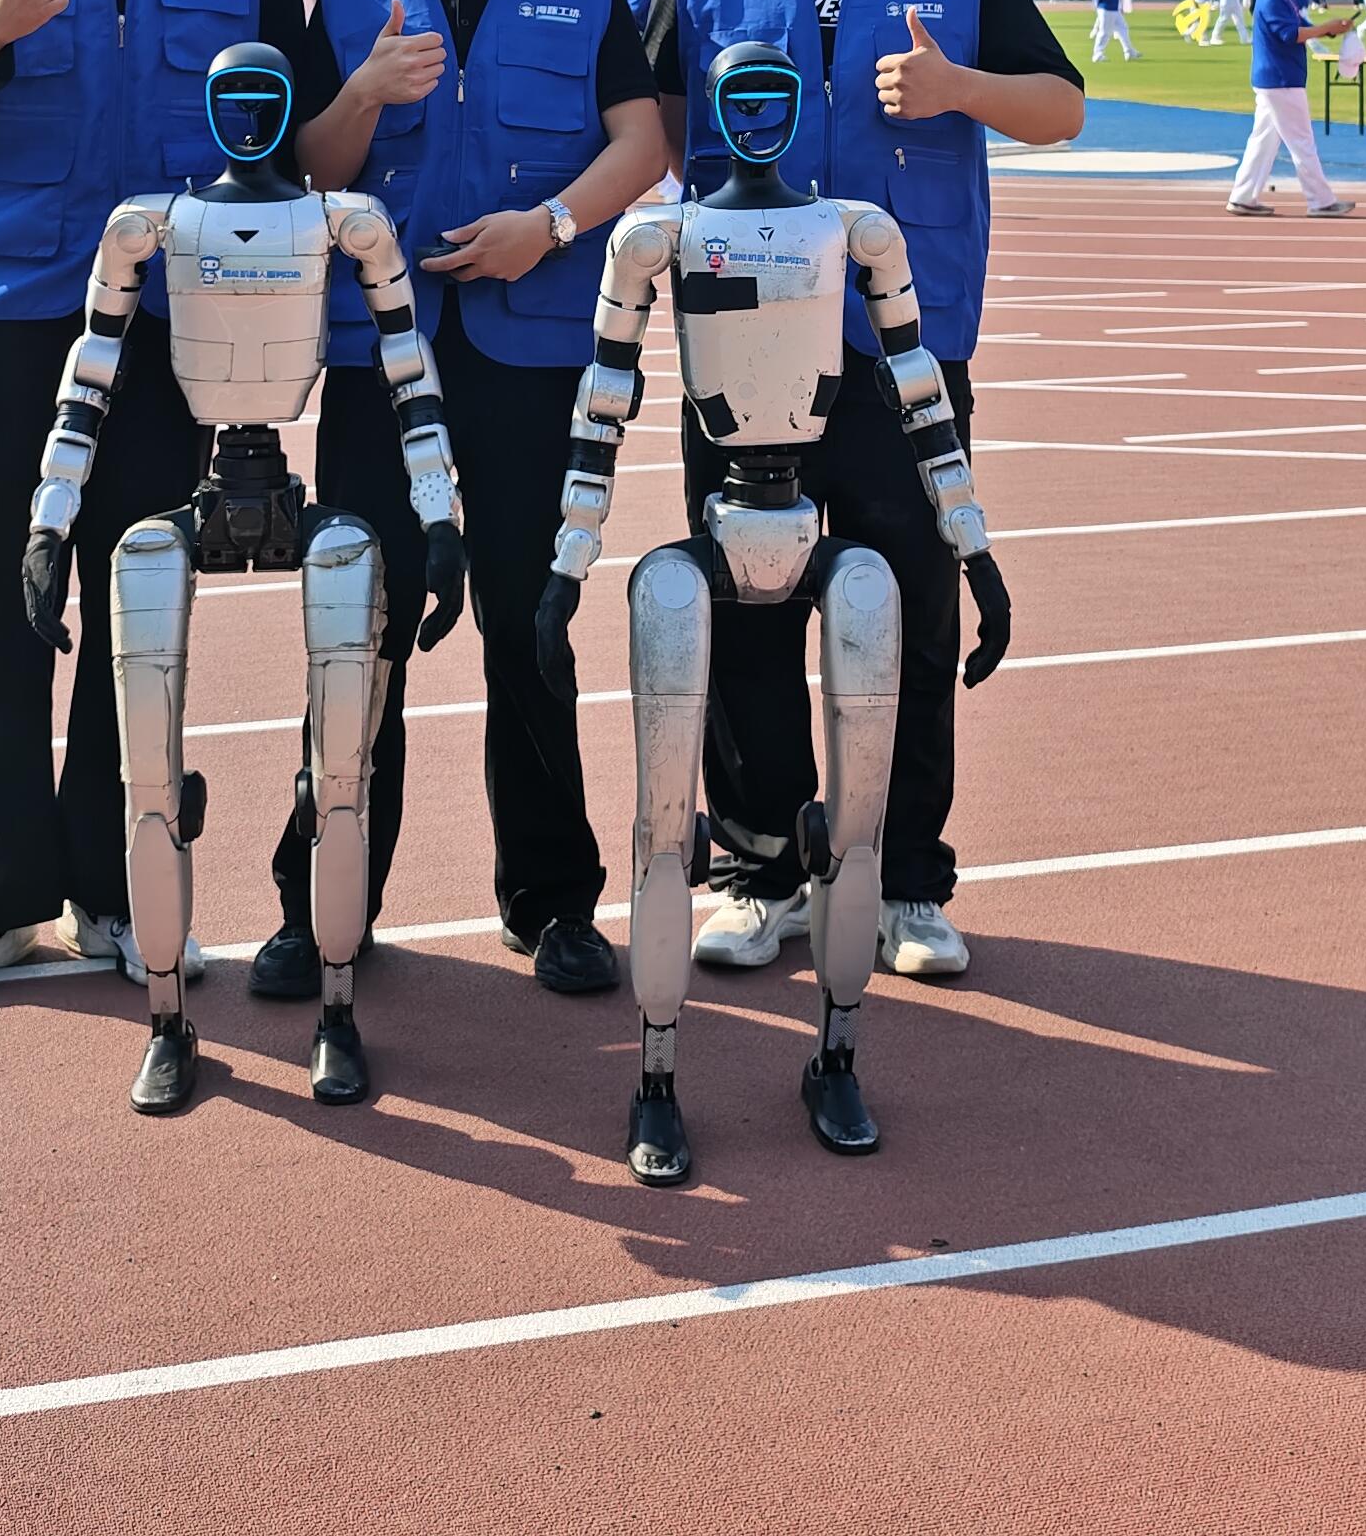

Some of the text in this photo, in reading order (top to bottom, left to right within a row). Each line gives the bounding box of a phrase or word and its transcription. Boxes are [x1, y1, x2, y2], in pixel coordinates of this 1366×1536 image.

[728, 253, 811, 266] 智能机器人服务中心
